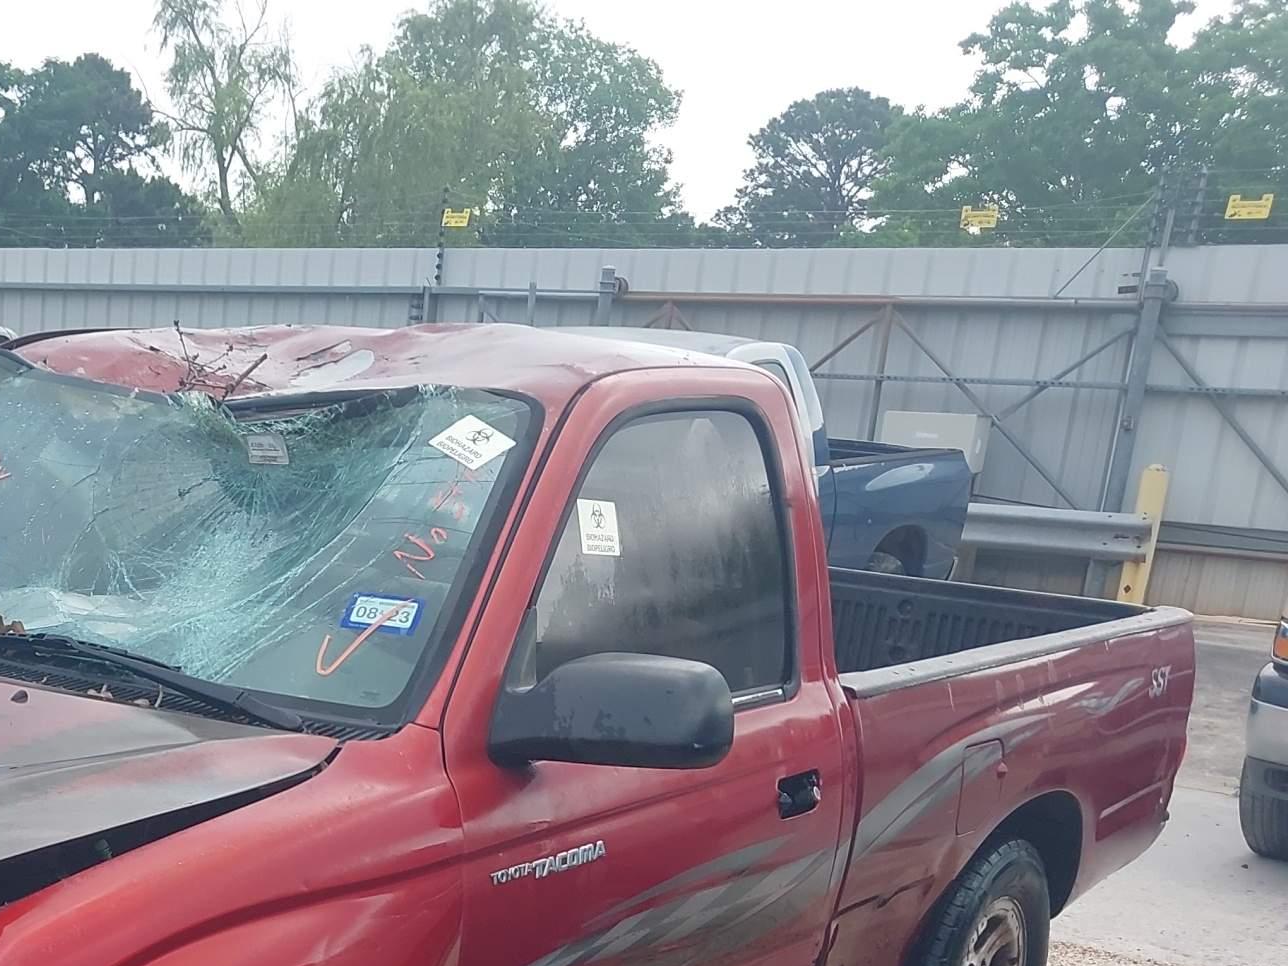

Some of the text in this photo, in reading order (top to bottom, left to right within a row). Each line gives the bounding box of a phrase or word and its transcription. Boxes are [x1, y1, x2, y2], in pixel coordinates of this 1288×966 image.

[445, 434, 483, 459] BIOHAZARD
[585, 532, 615, 543] BIOHAZARD
[490, 839, 606, 885] TOYOTA TACOMA
